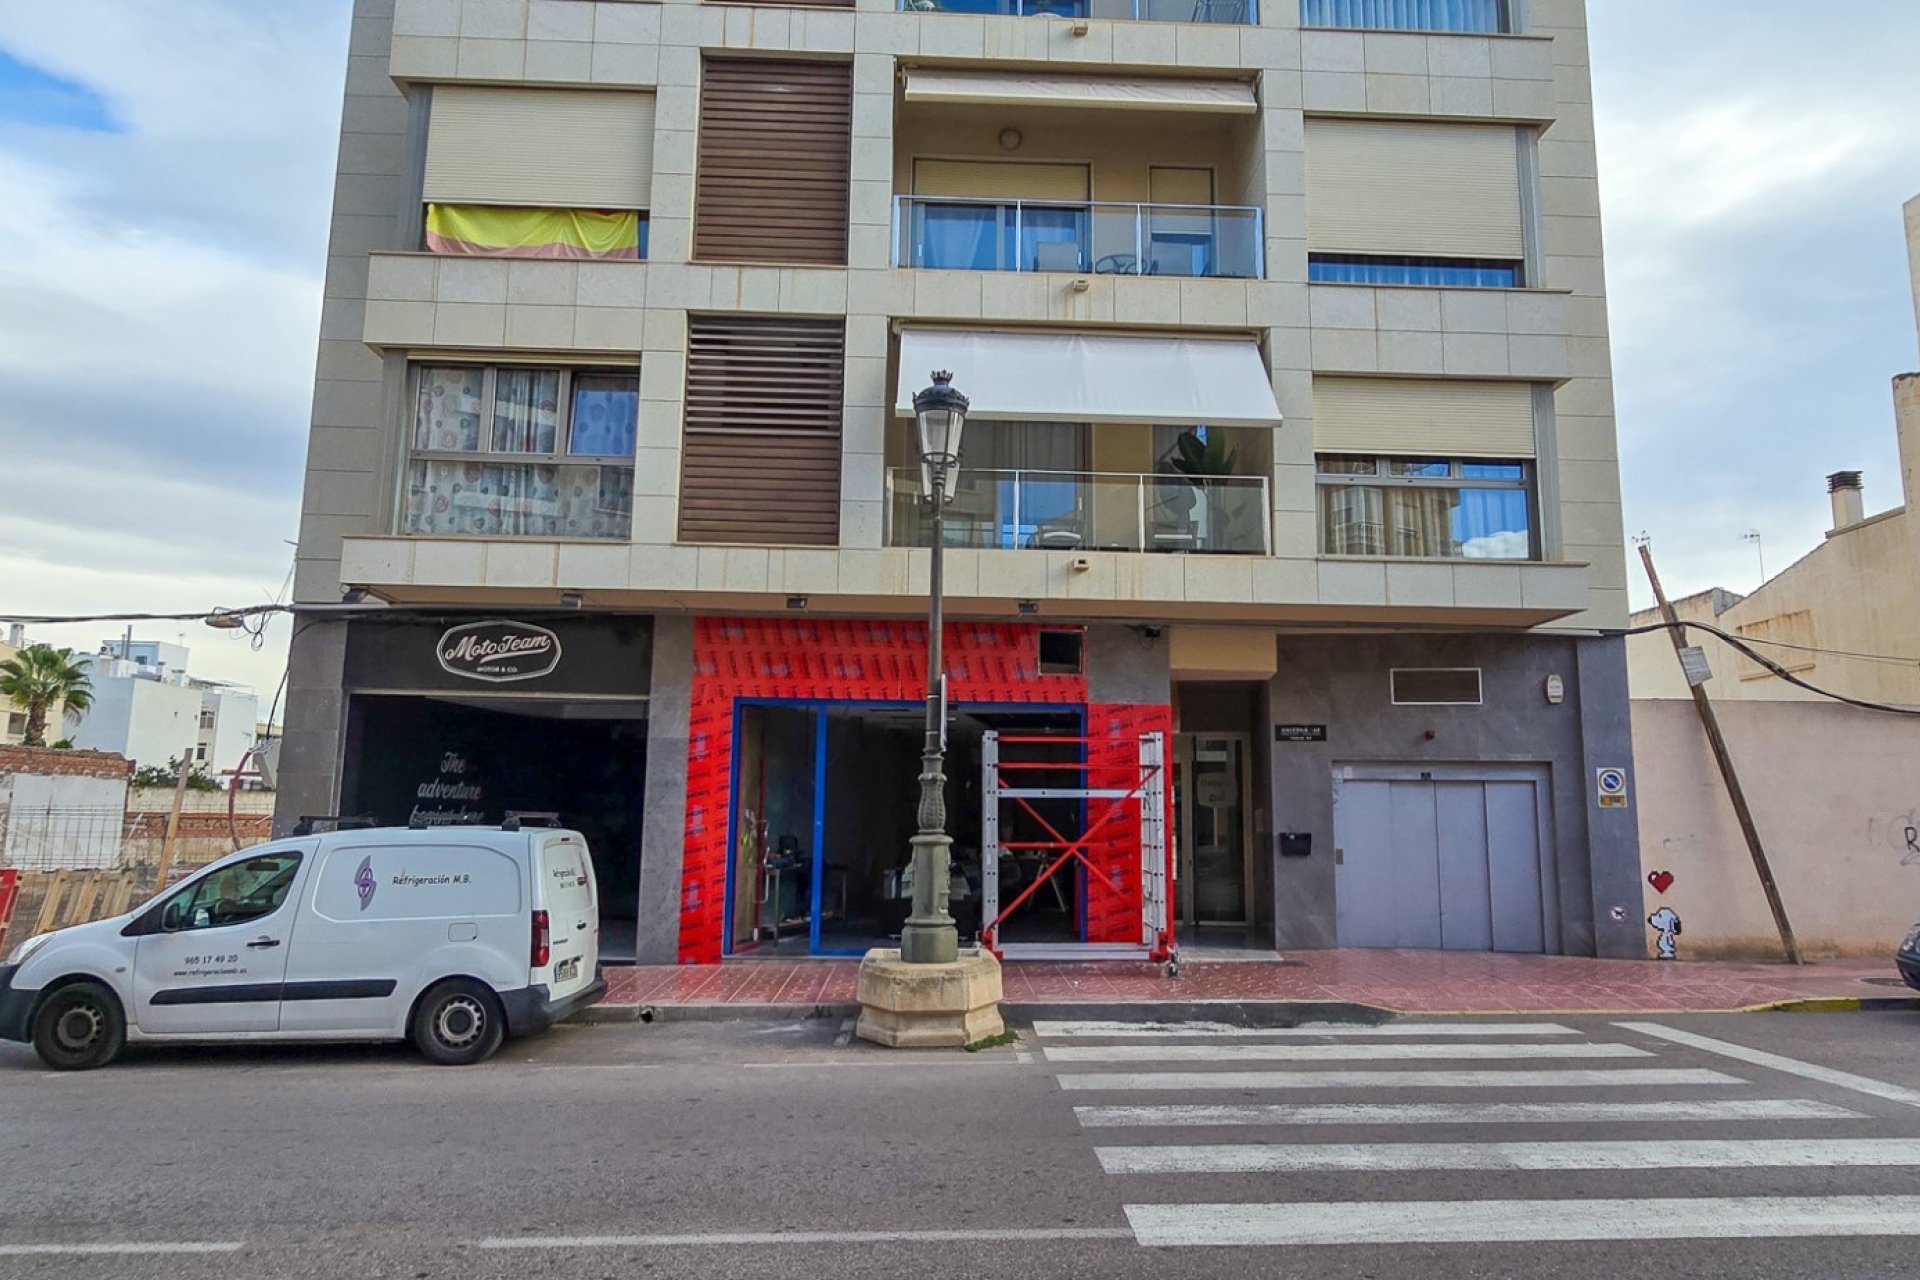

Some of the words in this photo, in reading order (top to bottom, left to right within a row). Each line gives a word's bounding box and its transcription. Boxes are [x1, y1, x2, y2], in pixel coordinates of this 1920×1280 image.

[440, 751, 465, 774] The
[417, 777, 482, 799] adventure
[392, 874, 450, 887] Refrigeración
[203, 955, 212, 964] 17
[215, 955, 226, 964] 49
